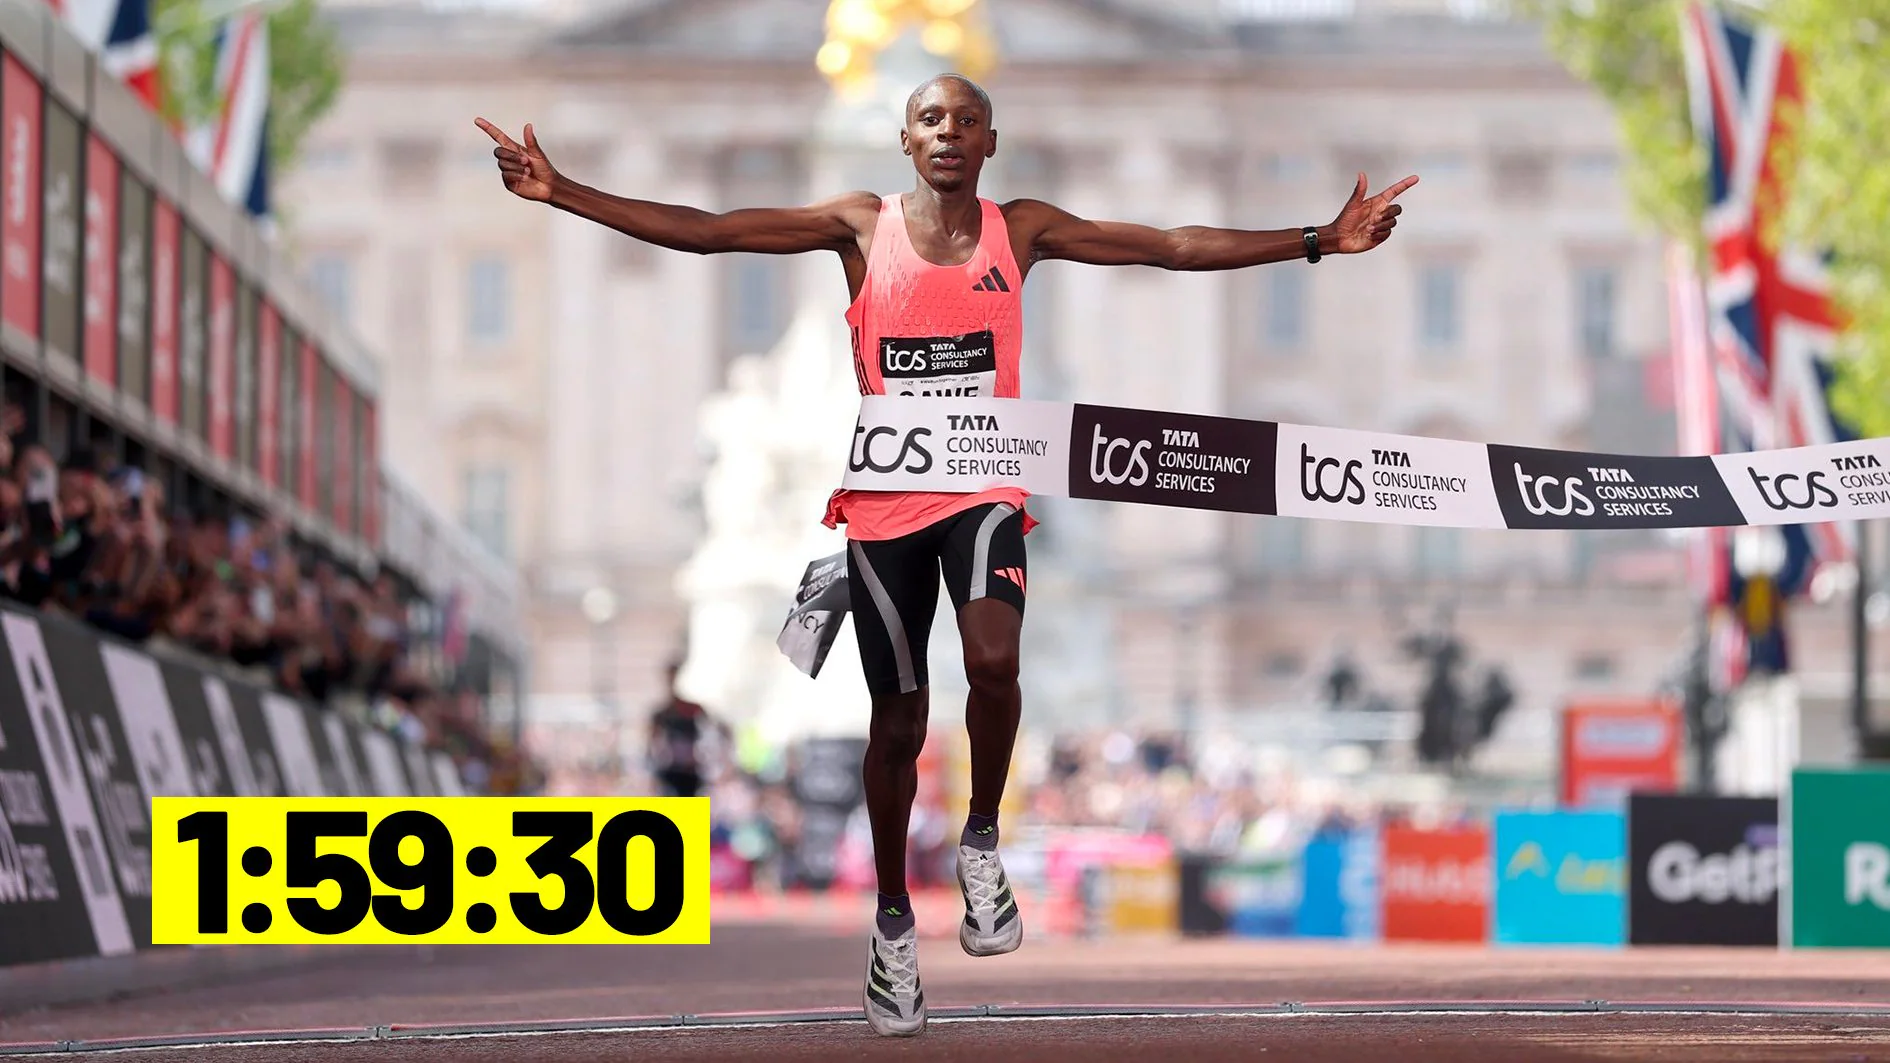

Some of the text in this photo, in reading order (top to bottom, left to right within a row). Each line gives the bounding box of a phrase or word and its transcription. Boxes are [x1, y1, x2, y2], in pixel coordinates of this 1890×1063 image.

[930, 343, 956, 351] TATA
[930, 348, 988, 361] CONSULTANCY
[886, 344, 926, 371] tcs
[931, 360, 969, 370] SERVICES
[947, 415, 999, 431] TATA
[849, 414, 933, 474] tcs
[946, 437, 1048, 456] CONSULTANCY
[1162, 429, 1200, 448] TATA
[1090, 423, 1152, 487] tcs
[1158, 451, 1251, 475] CONSULTANCY
[1371, 449, 1411, 468] TATA
[1830, 454, 1881, 471] TATA
[946, 459, 1021, 476] SERVICES
[1301, 442, 1365, 505] tcs
[1587, 467, 1635, 483] TATA
[1155, 472, 1215, 493] SERVICES
[1372, 471, 1466, 493] CONSULTANCY
[1513, 462, 1595, 517] tcs
[1747, 466, 1839, 510] tcs
[1374, 492, 1437, 511] SERVICES
[1595, 485, 1700, 500] CONSULTANCY
[1603, 502, 1673, 516] SERVICES
